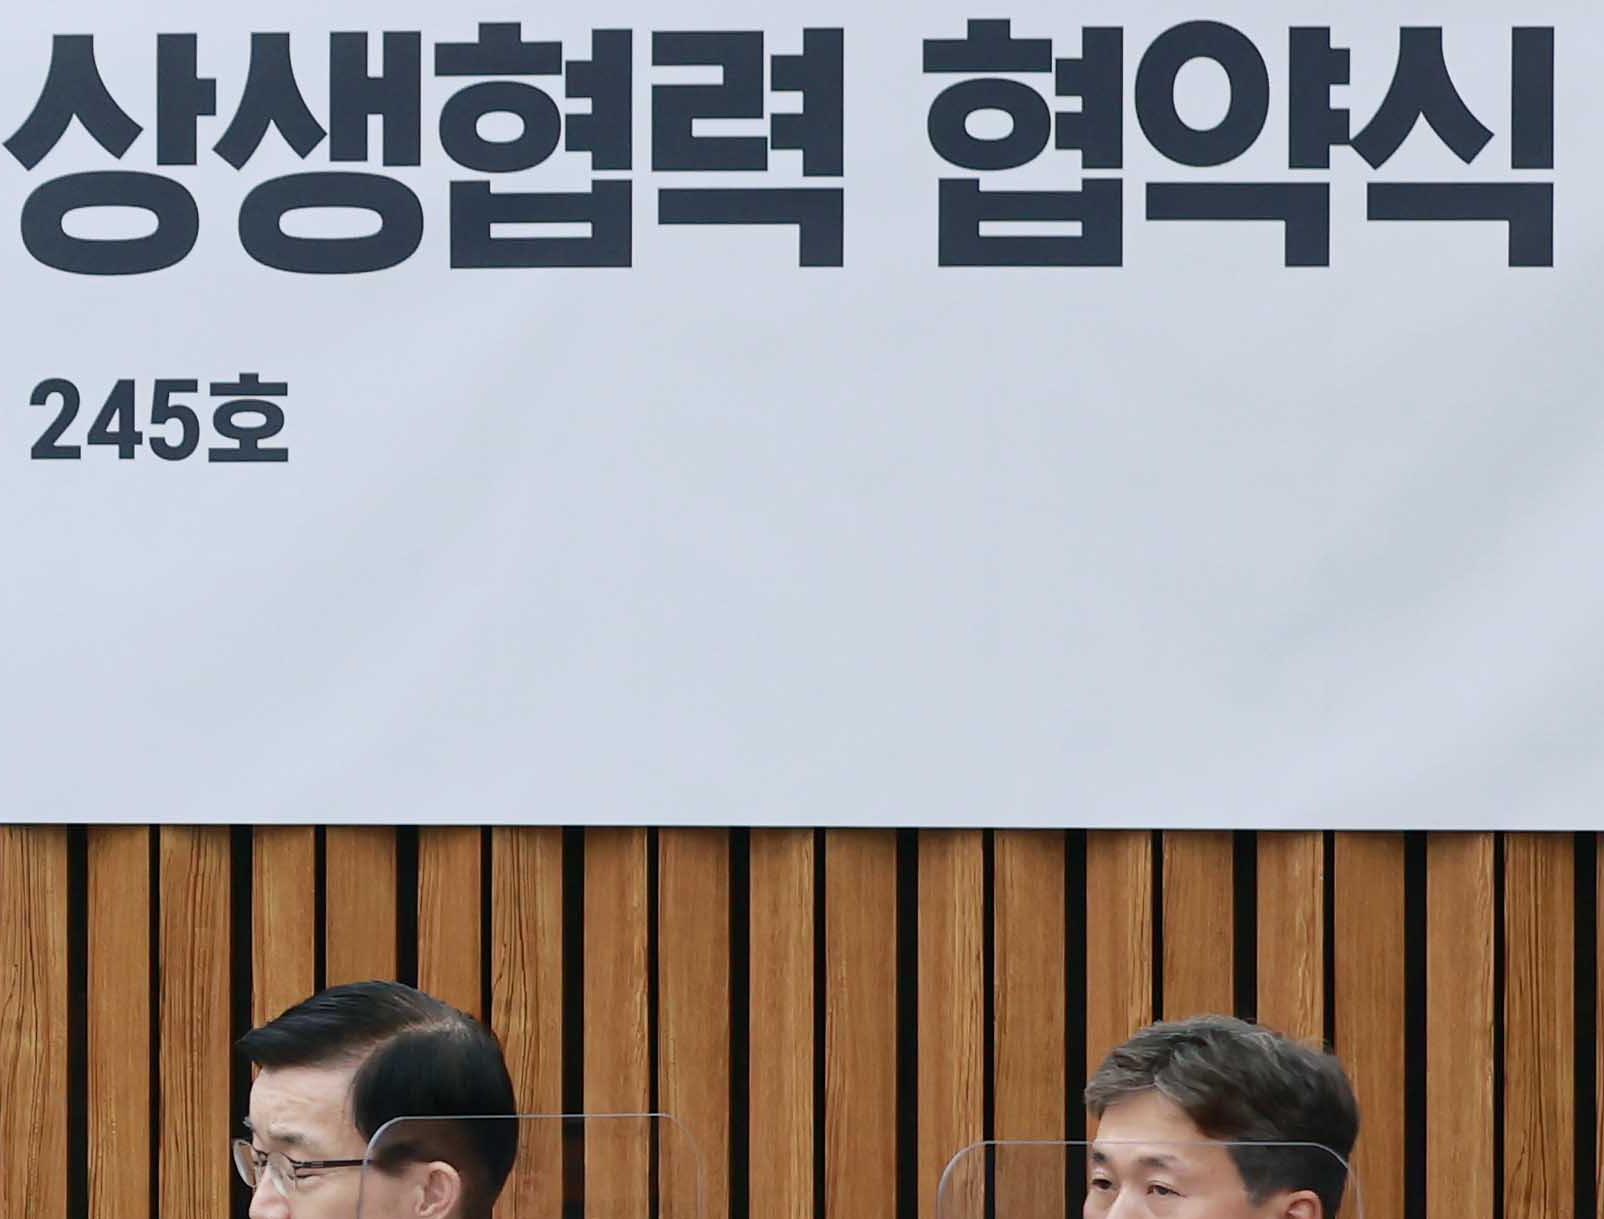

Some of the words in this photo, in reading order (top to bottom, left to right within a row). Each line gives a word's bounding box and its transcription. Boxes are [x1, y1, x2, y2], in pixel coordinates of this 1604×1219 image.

[0, 19, 846, 278] 상생협력
[920, 15, 1557, 270] 협약식
[28, 371, 289, 464] 245호
